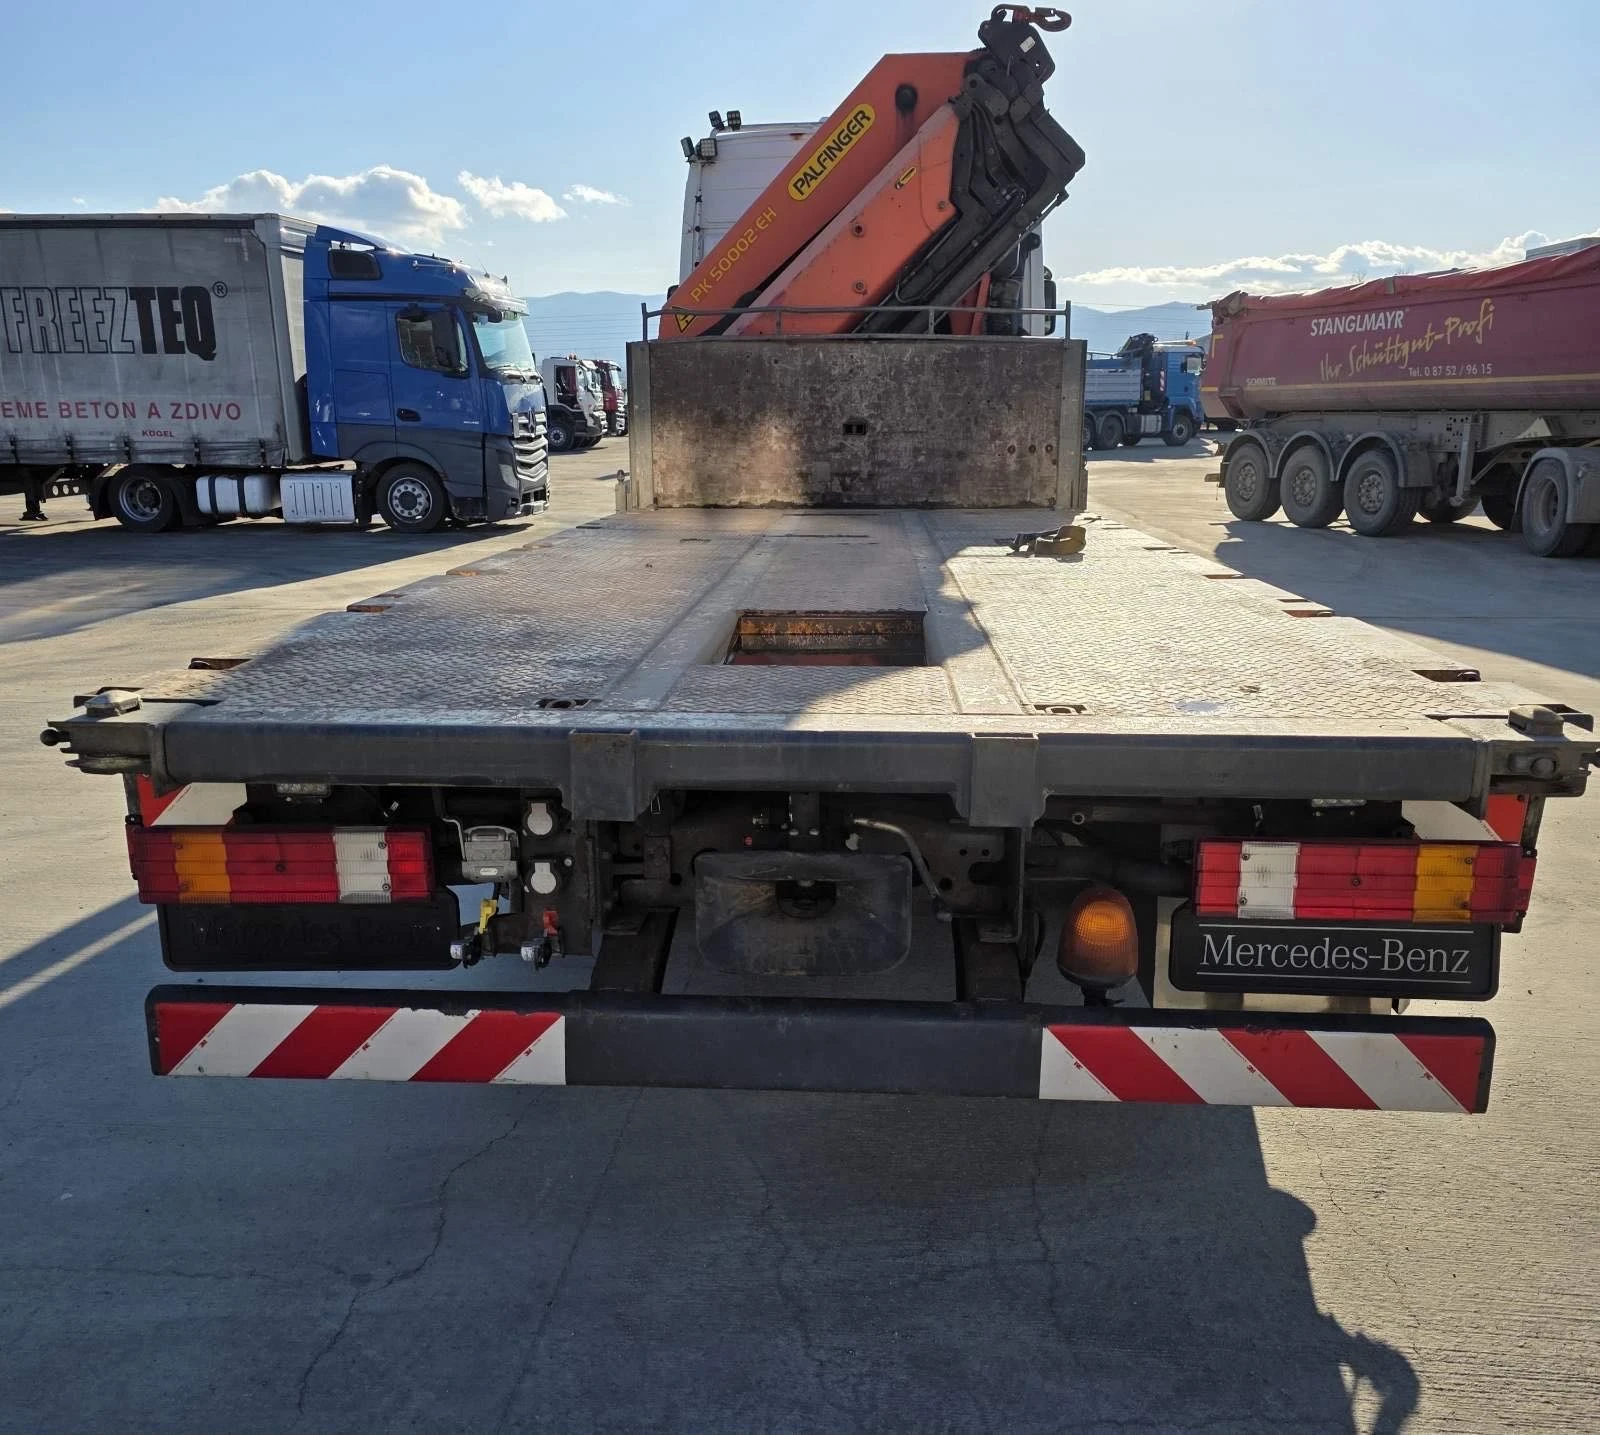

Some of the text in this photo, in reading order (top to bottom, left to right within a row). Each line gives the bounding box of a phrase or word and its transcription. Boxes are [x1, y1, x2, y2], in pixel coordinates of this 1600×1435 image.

[792, 110, 871, 196] PALFINGER
[690, 278, 712, 302] PK
[1310, 310, 1404, 336] STANGLMAYR
[1320, 353, 1343, 381] Ihr
[1445, 365, 1457, 376] 52
[1465, 364, 1478, 375] 96
[1481, 363, 1493, 375] 15
[59, 402, 136, 419] BETON
[148, 403, 161, 418] A
[171, 403, 241, 420] ZDIVO
[1200, 933, 1471, 975] Mercedes-Benz
